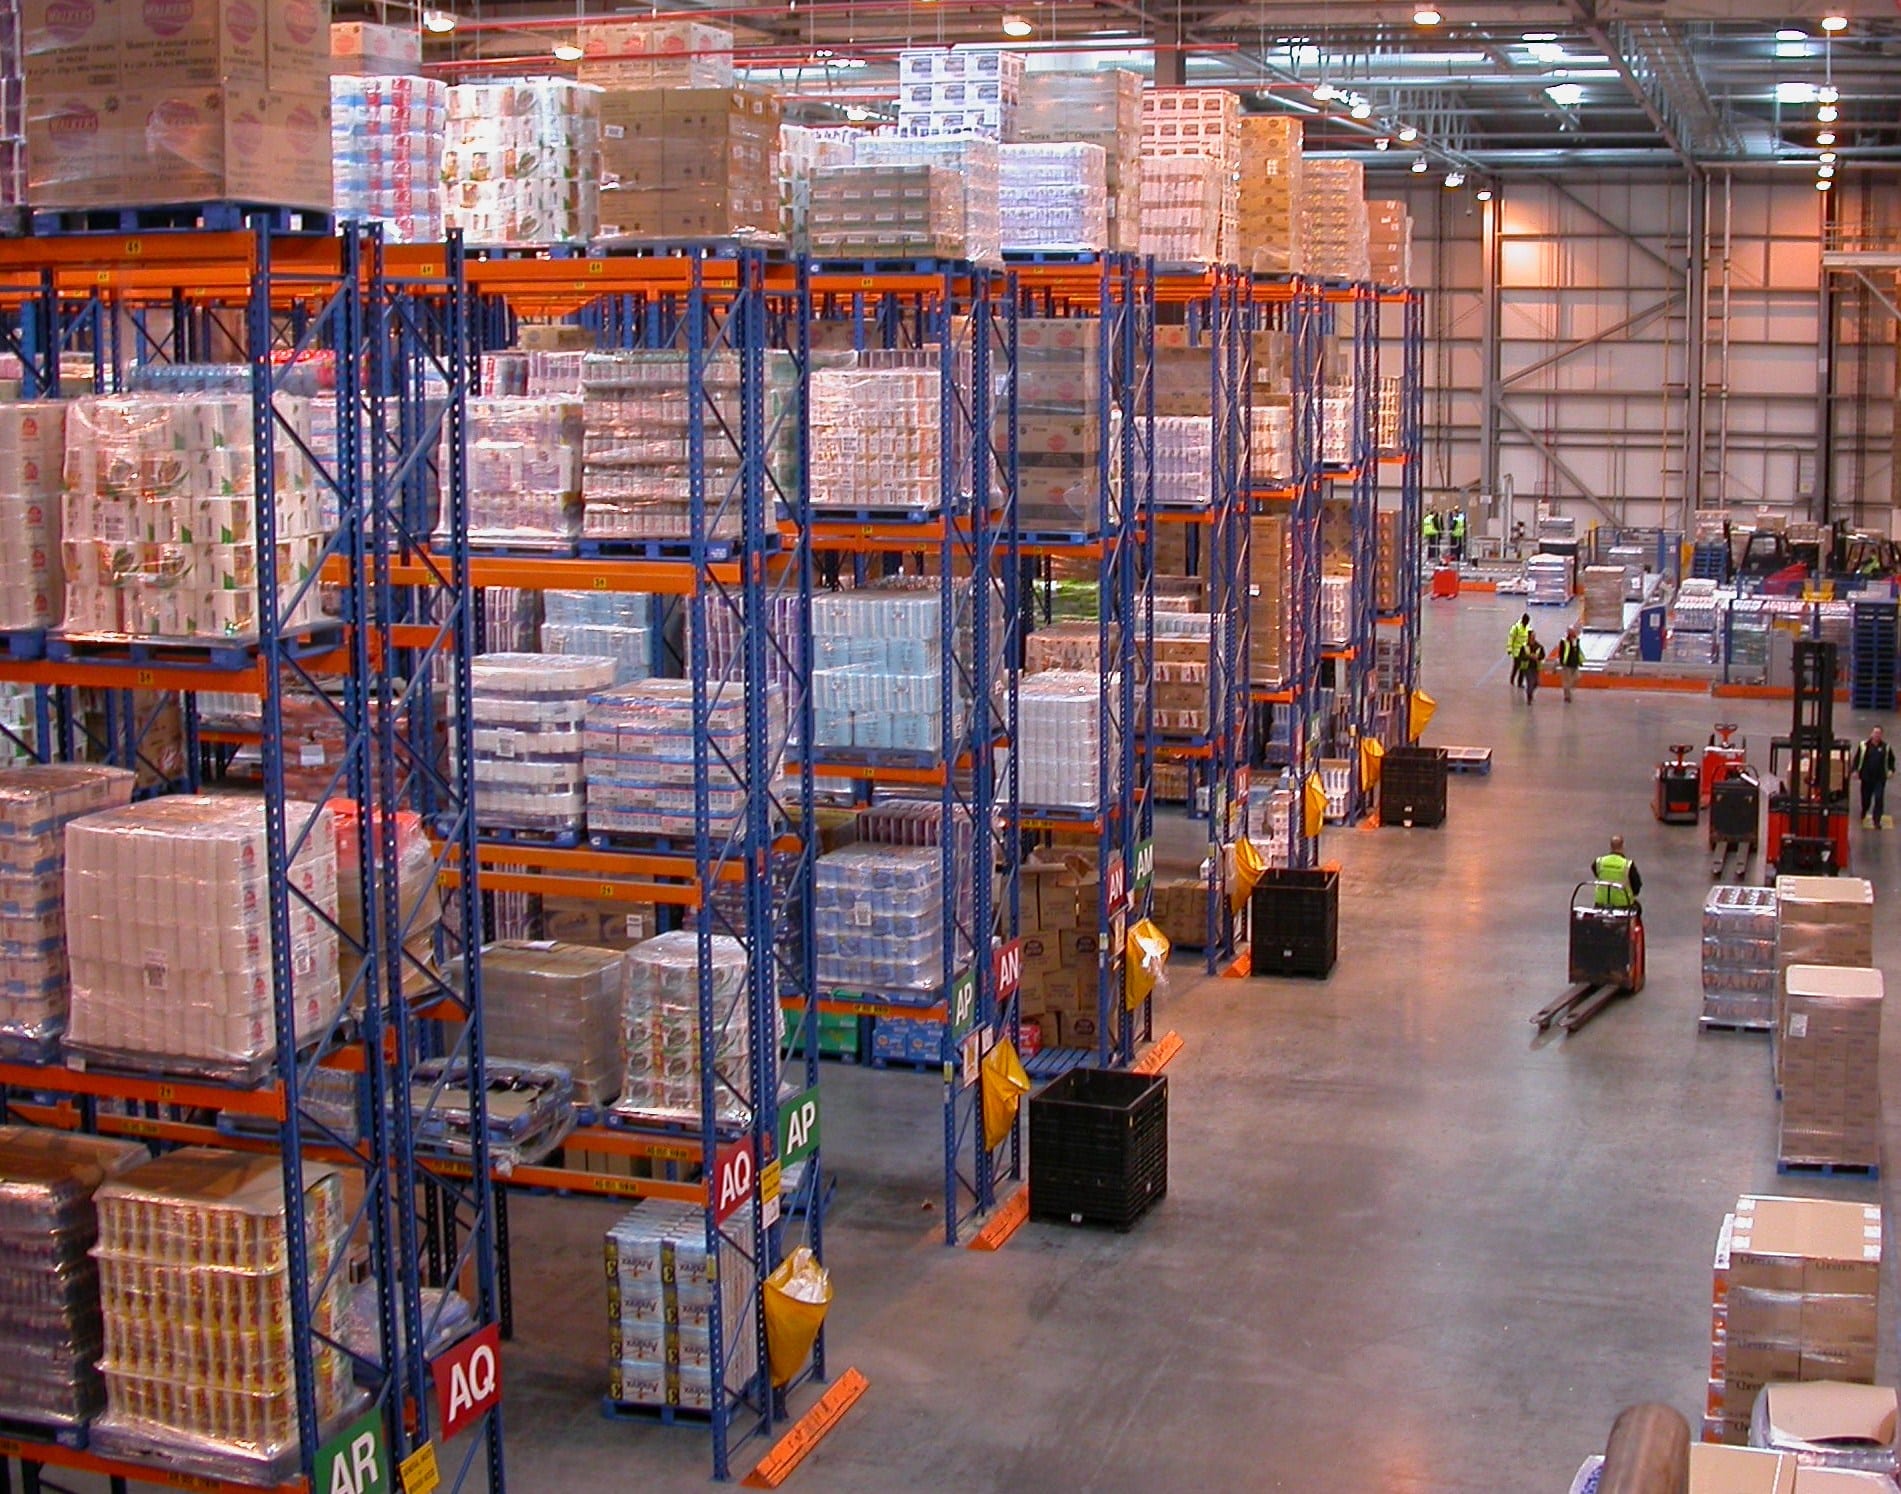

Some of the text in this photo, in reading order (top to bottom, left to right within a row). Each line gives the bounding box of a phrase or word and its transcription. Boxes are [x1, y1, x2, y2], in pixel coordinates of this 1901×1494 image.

[1000, 947, 1018, 992] AN
[955, 982, 973, 1026] AP
[786, 1101, 815, 1155] AP
[720, 1151, 750, 1210] AQ
[448, 1345, 496, 1423] AQ
[331, 1432, 378, 1494] AR
